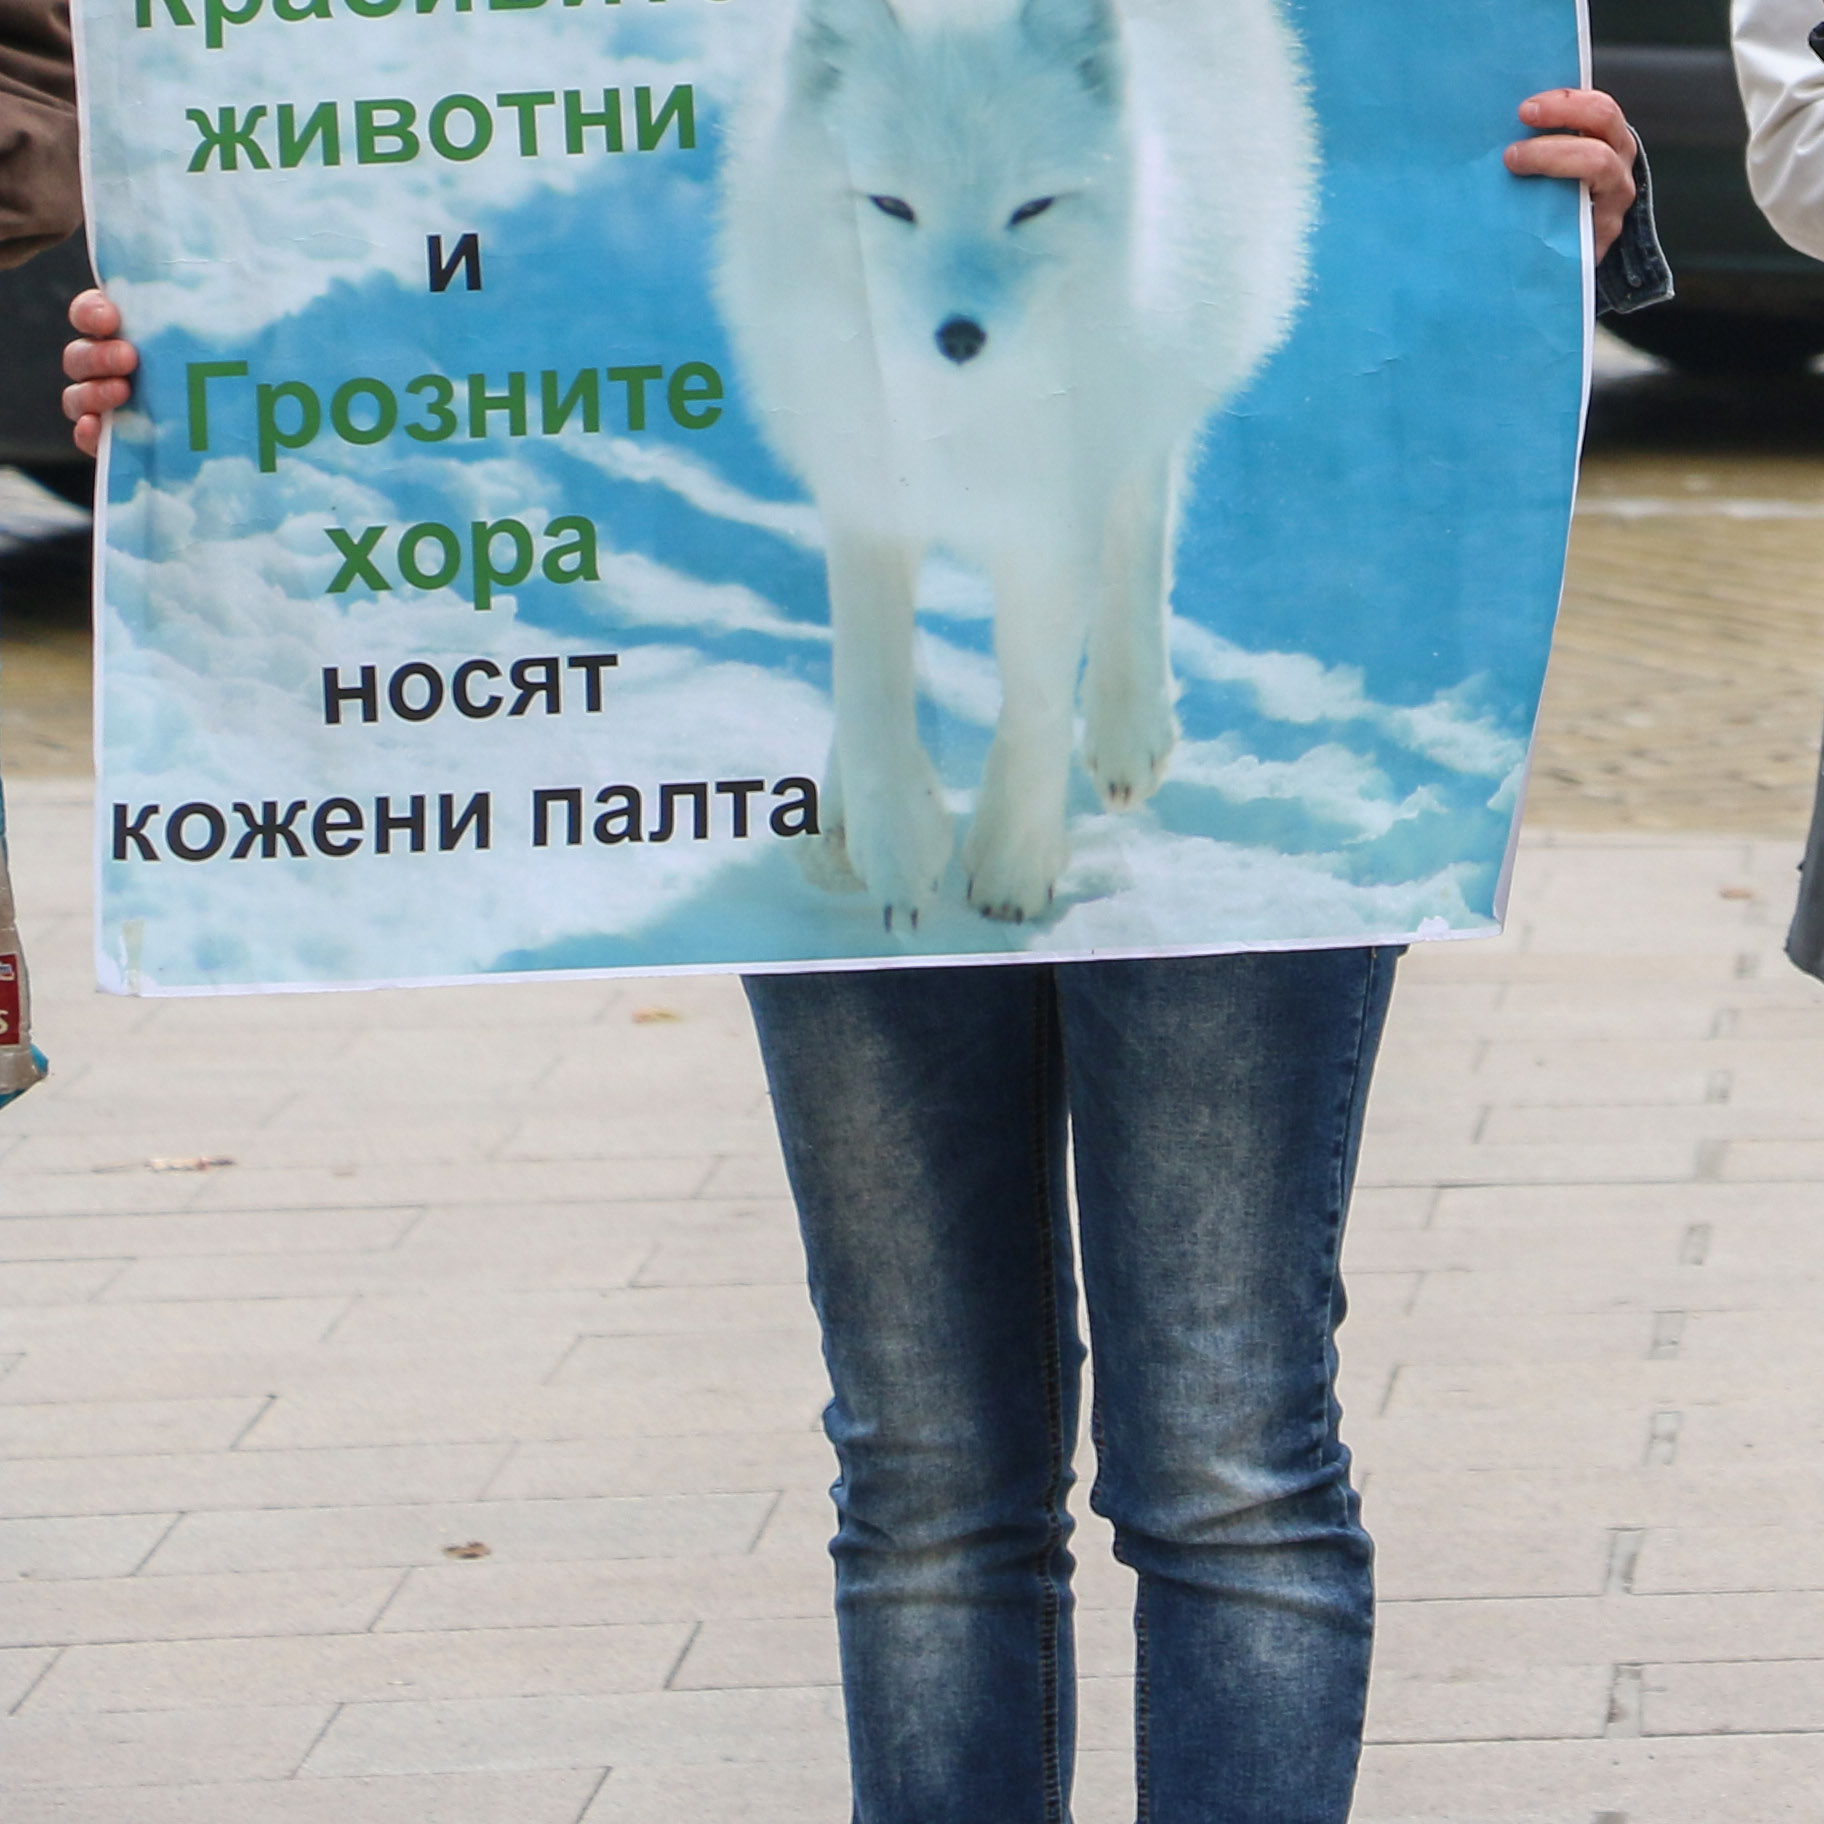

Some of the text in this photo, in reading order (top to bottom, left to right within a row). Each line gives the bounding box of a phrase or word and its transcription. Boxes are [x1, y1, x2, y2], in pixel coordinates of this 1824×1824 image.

[186, 84, 697, 173] животни
[427, 232, 483, 294] и
[186, 358, 725, 475] Грозните
[325, 512, 600, 612] хора
[322, 652, 619, 726] носят
[112, 776, 822, 863] кожени палта
